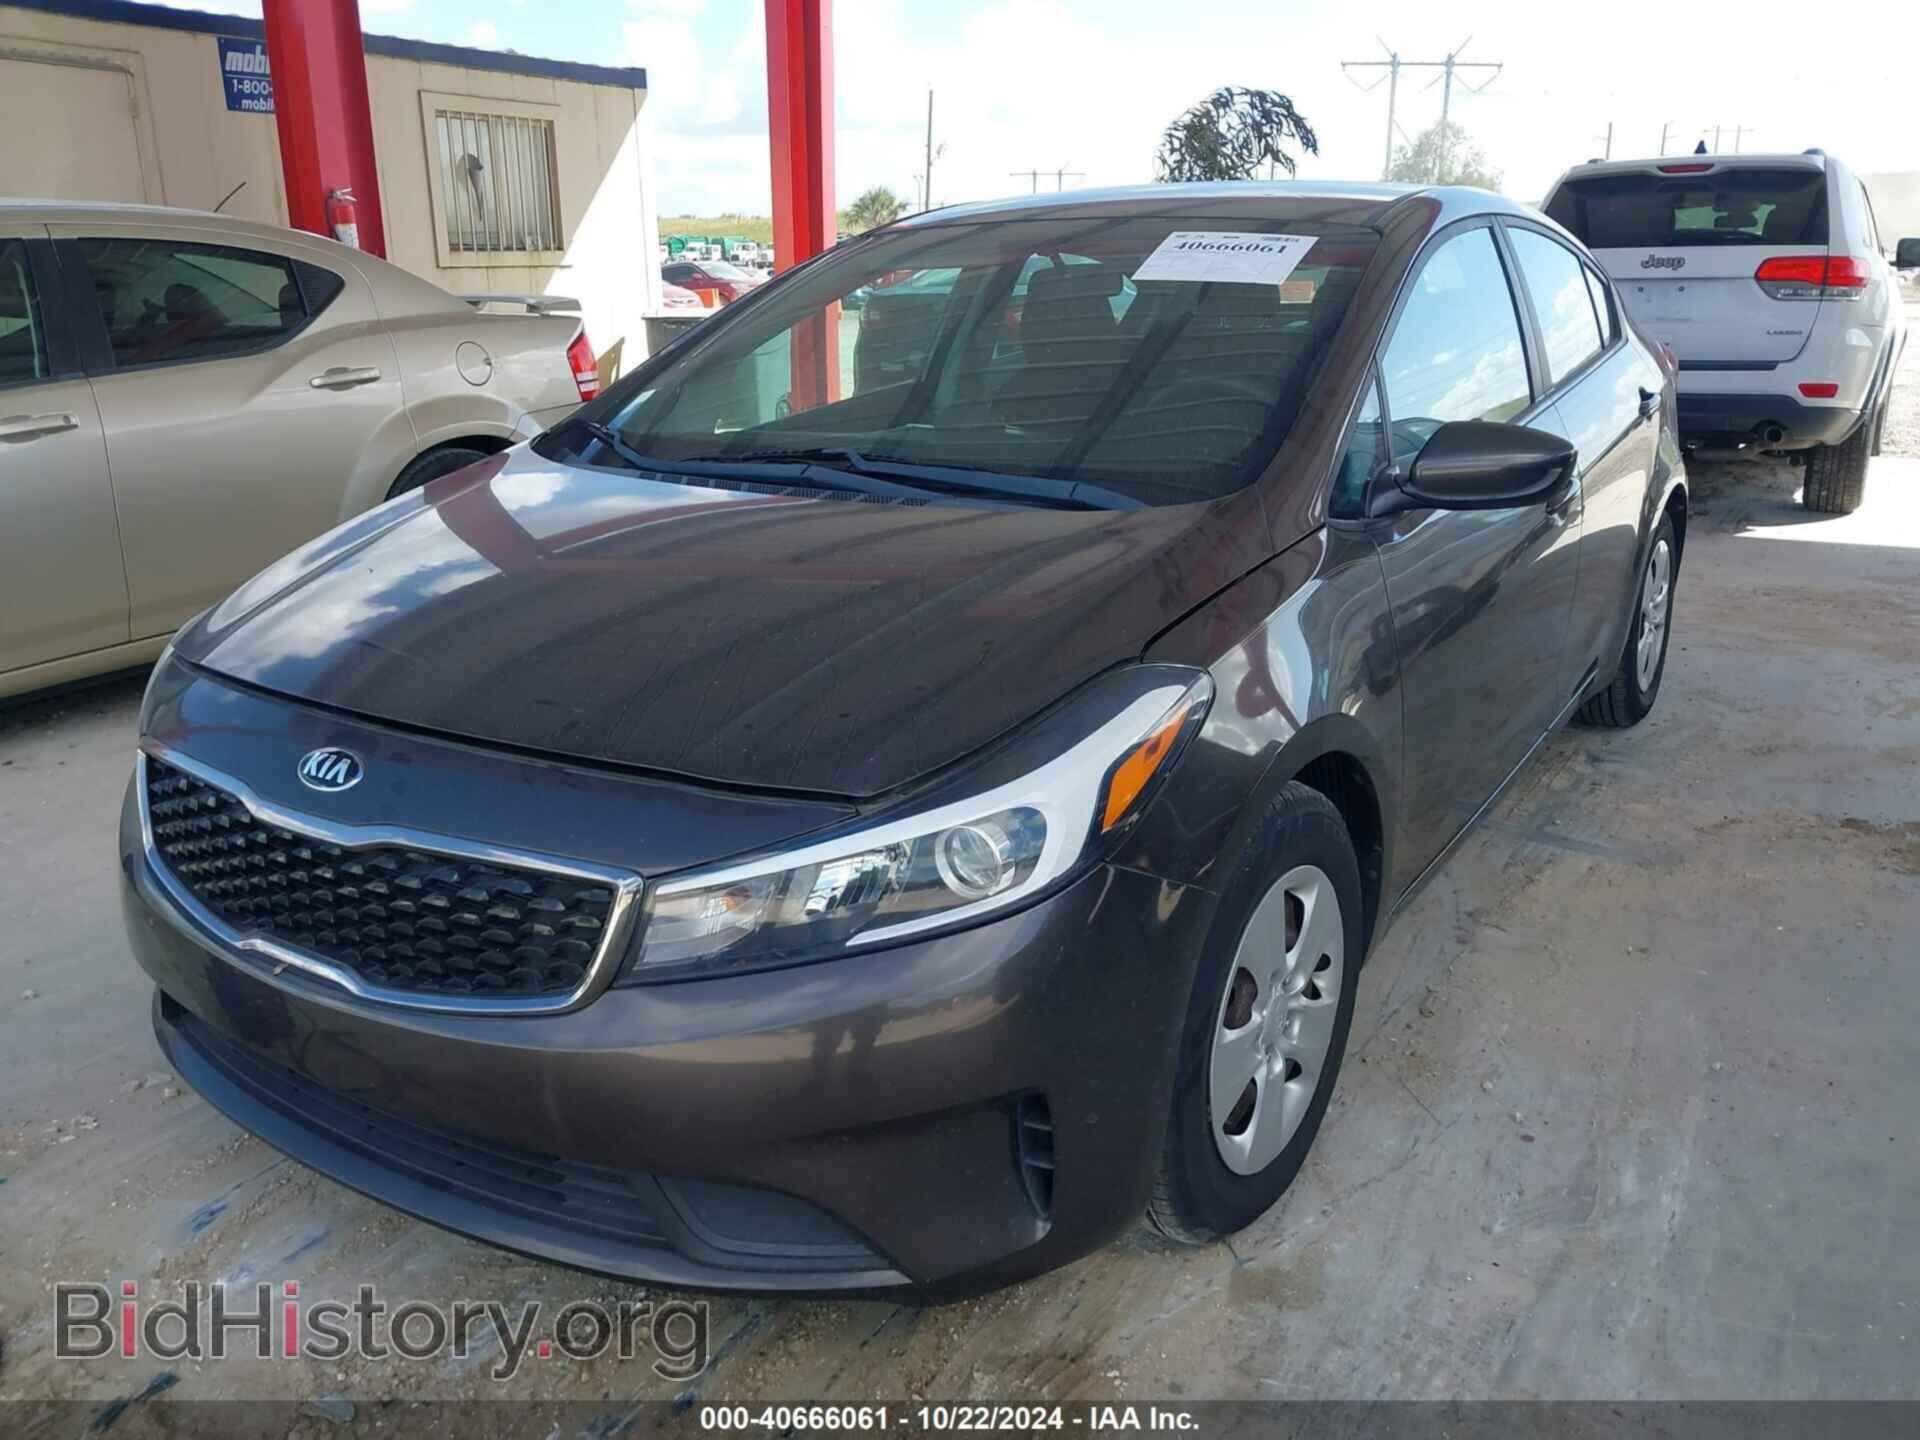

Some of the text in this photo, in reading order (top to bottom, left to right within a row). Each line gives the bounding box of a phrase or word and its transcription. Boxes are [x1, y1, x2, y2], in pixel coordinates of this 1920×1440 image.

[1173, 240, 1288, 254] 40666061
[1641, 254, 1686, 271] Jeep
[303, 751, 351, 784] KIA
